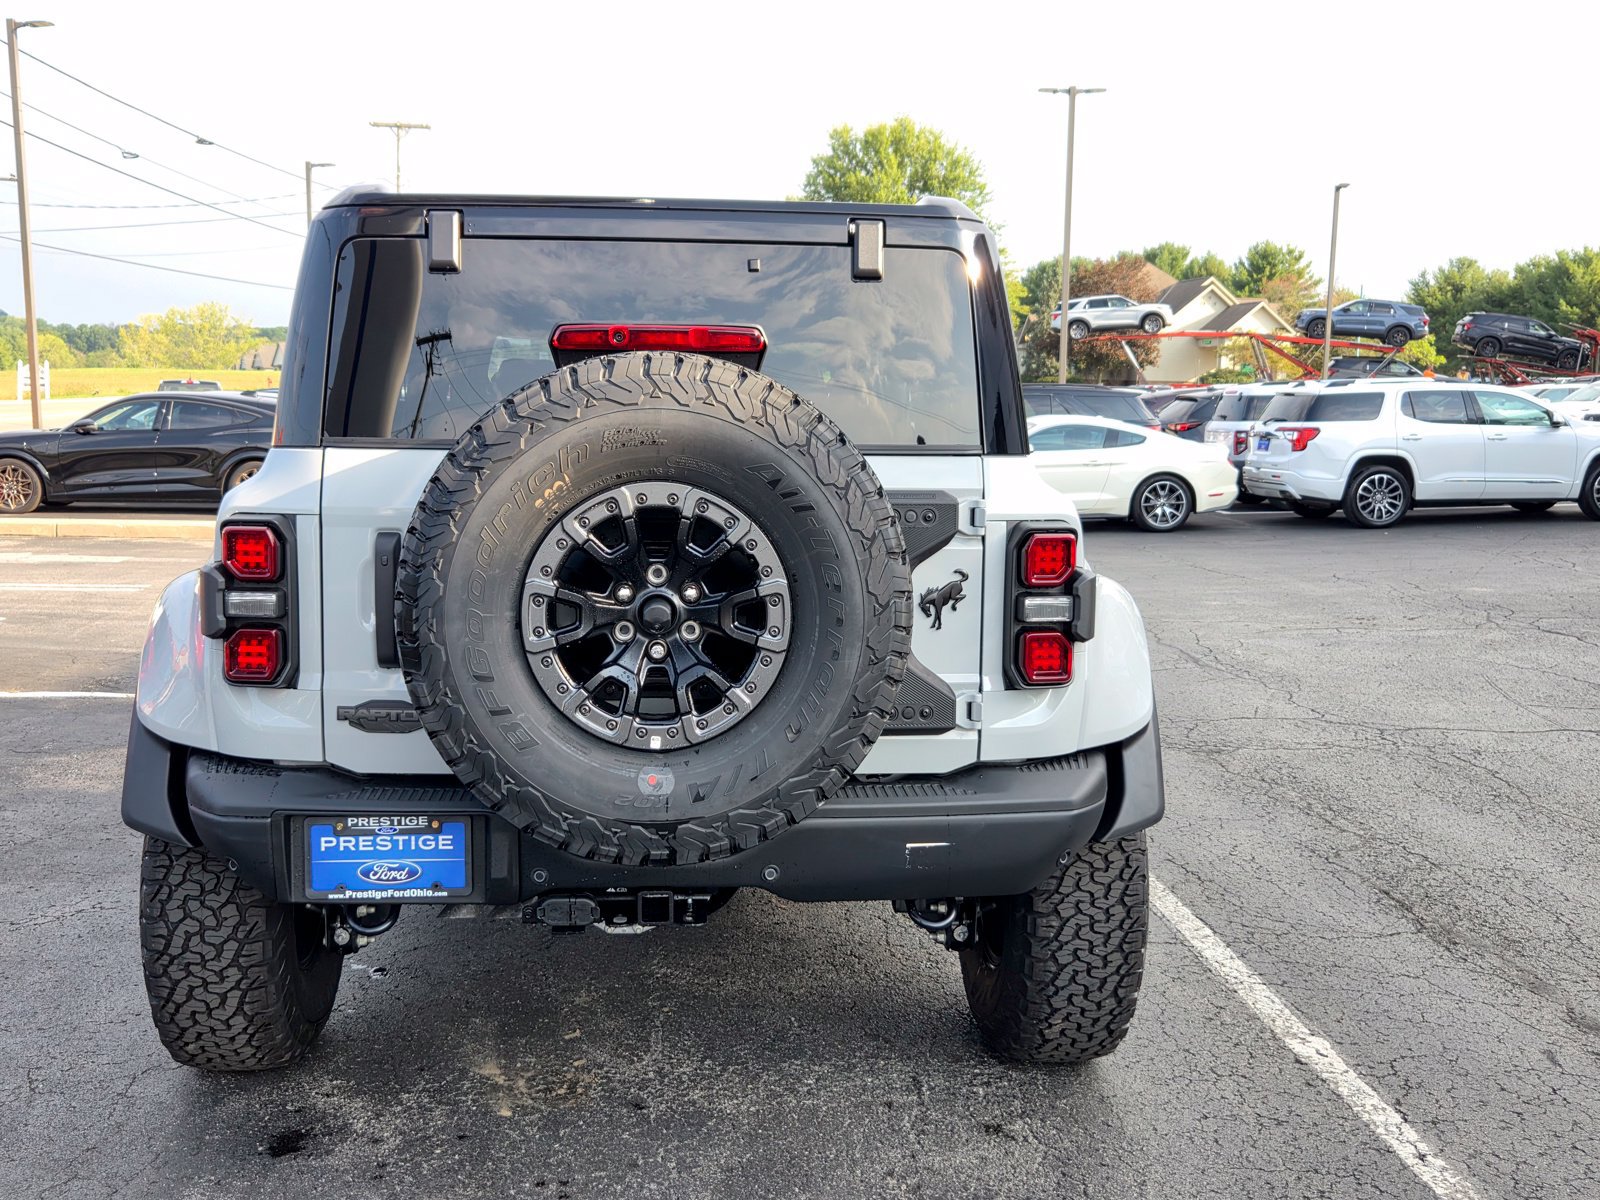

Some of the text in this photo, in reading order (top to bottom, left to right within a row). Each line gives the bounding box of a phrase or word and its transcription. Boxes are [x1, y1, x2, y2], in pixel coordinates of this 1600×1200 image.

[467, 443, 591, 753] BFGoodrich
[744, 462, 845, 744] All-Terrain
[337, 708, 420, 722] RAPTO
[347, 816, 428, 827] PRESTIGE
[320, 835, 454, 851] PRESTIGE
[369, 863, 409, 880] Ford
[328, 889, 448, 900] www.PrestigeFordOhio.com
